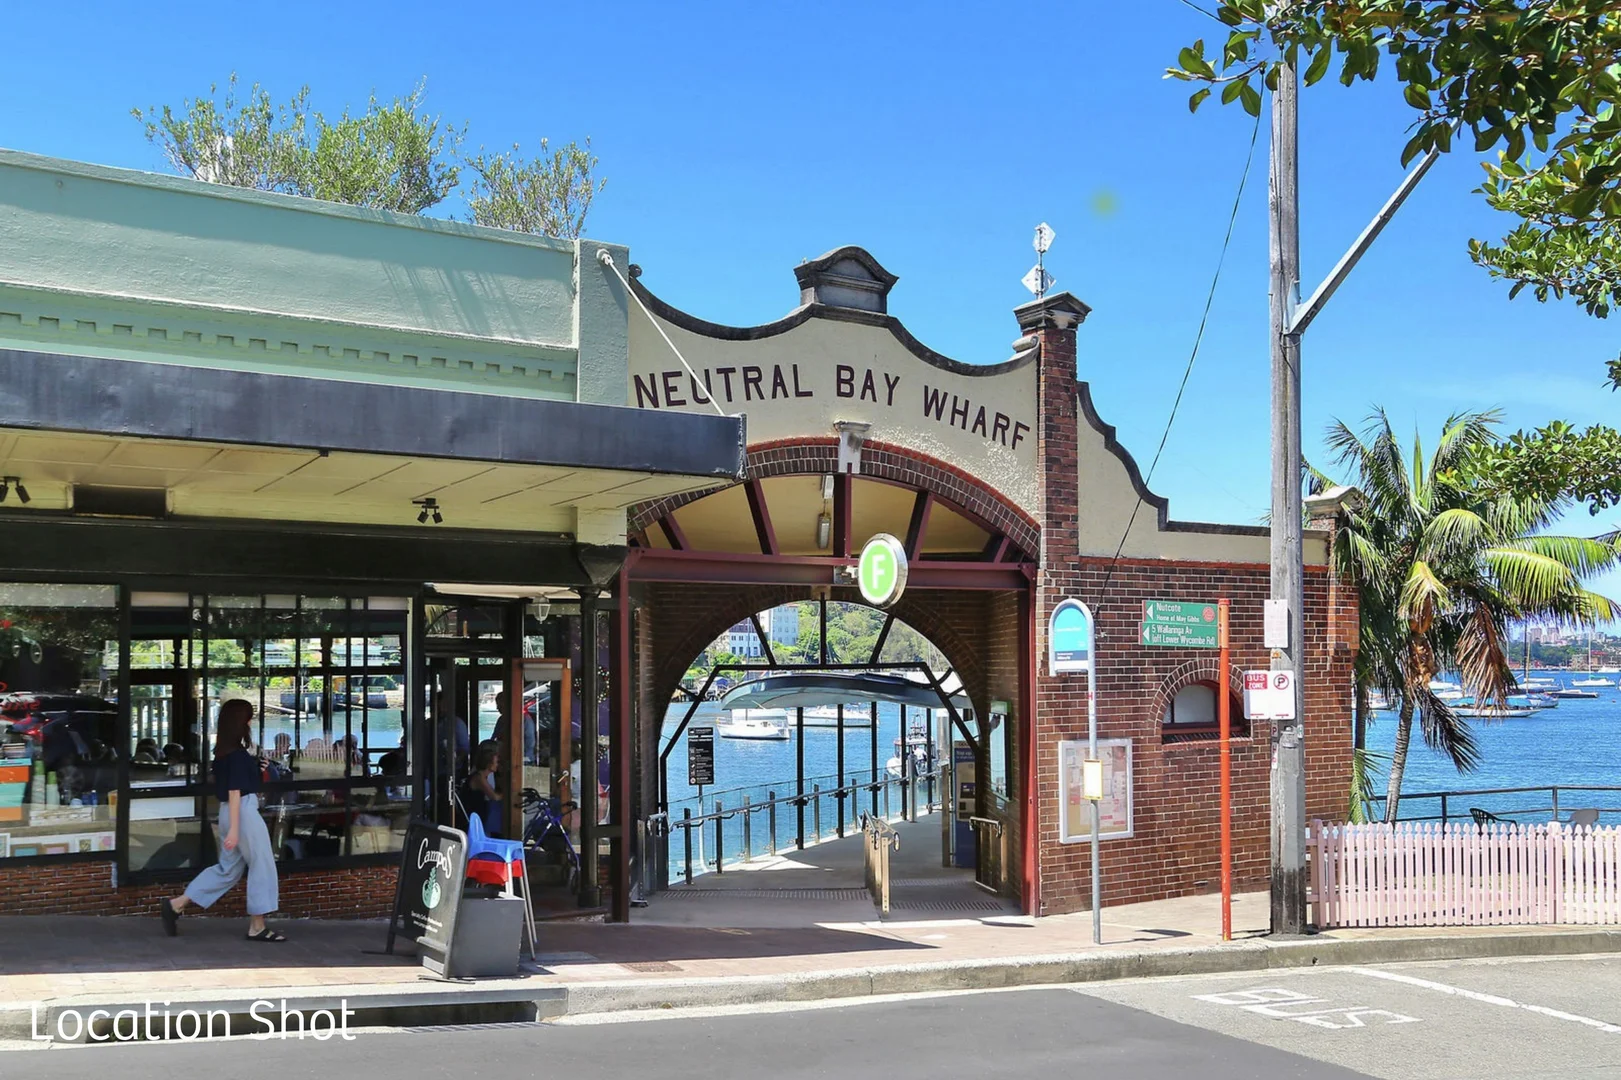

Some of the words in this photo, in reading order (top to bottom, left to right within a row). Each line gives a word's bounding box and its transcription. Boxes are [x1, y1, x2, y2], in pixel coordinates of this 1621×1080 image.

[633, 364, 813, 408] NEUTRAL
[836, 364, 900, 406] BAY
[924, 385, 1030, 450] WHARF
[872, 554, 886, 590] F
[1156, 602, 1181, 612] Nutcote
[1162, 635, 1179, 644] Lower
[1180, 635, 1205, 646] Wycombe
[1246, 674, 1265, 682] BUS
[1189, 988, 1424, 1029] BUS
